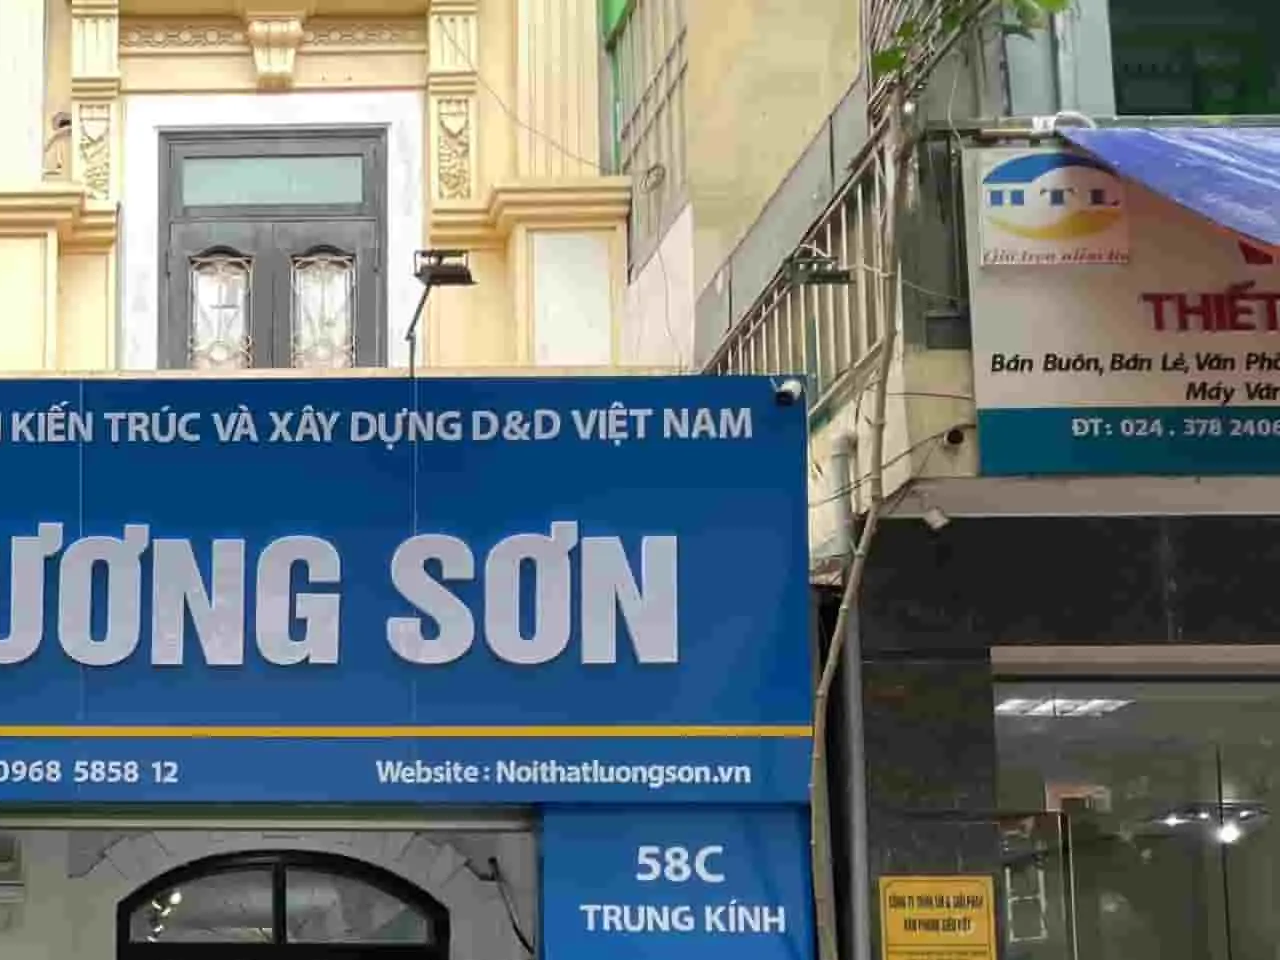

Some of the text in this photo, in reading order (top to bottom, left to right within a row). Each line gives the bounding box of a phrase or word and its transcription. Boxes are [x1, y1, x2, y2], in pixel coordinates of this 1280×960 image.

[991, 353, 1033, 372] Bán
[1043, 352, 1104, 376] Buôn,
[1110, 353, 1152, 372] Bán
[1185, 381, 1235, 406] Máy
[11, 400, 93, 443] KIẾN
[103, 405, 201, 443] TRÚC
[211, 404, 258, 442] VÀ
[268, 404, 341, 442] XÂY
[350, 407, 463, 450] DỰNG
[472, 408, 561, 441] D&D
[571, 401, 653, 446] VIỆT
[663, 406, 754, 439] NAM
[1183, 418, 1222, 436] 378
[386, 520, 680, 667] SƠN
[72, 760, 140, 783] 5858
[151, 761, 179, 784] 12
[634, 845, 726, 883] 58C
[579, 899, 786, 933] TRUNG KÍNH
